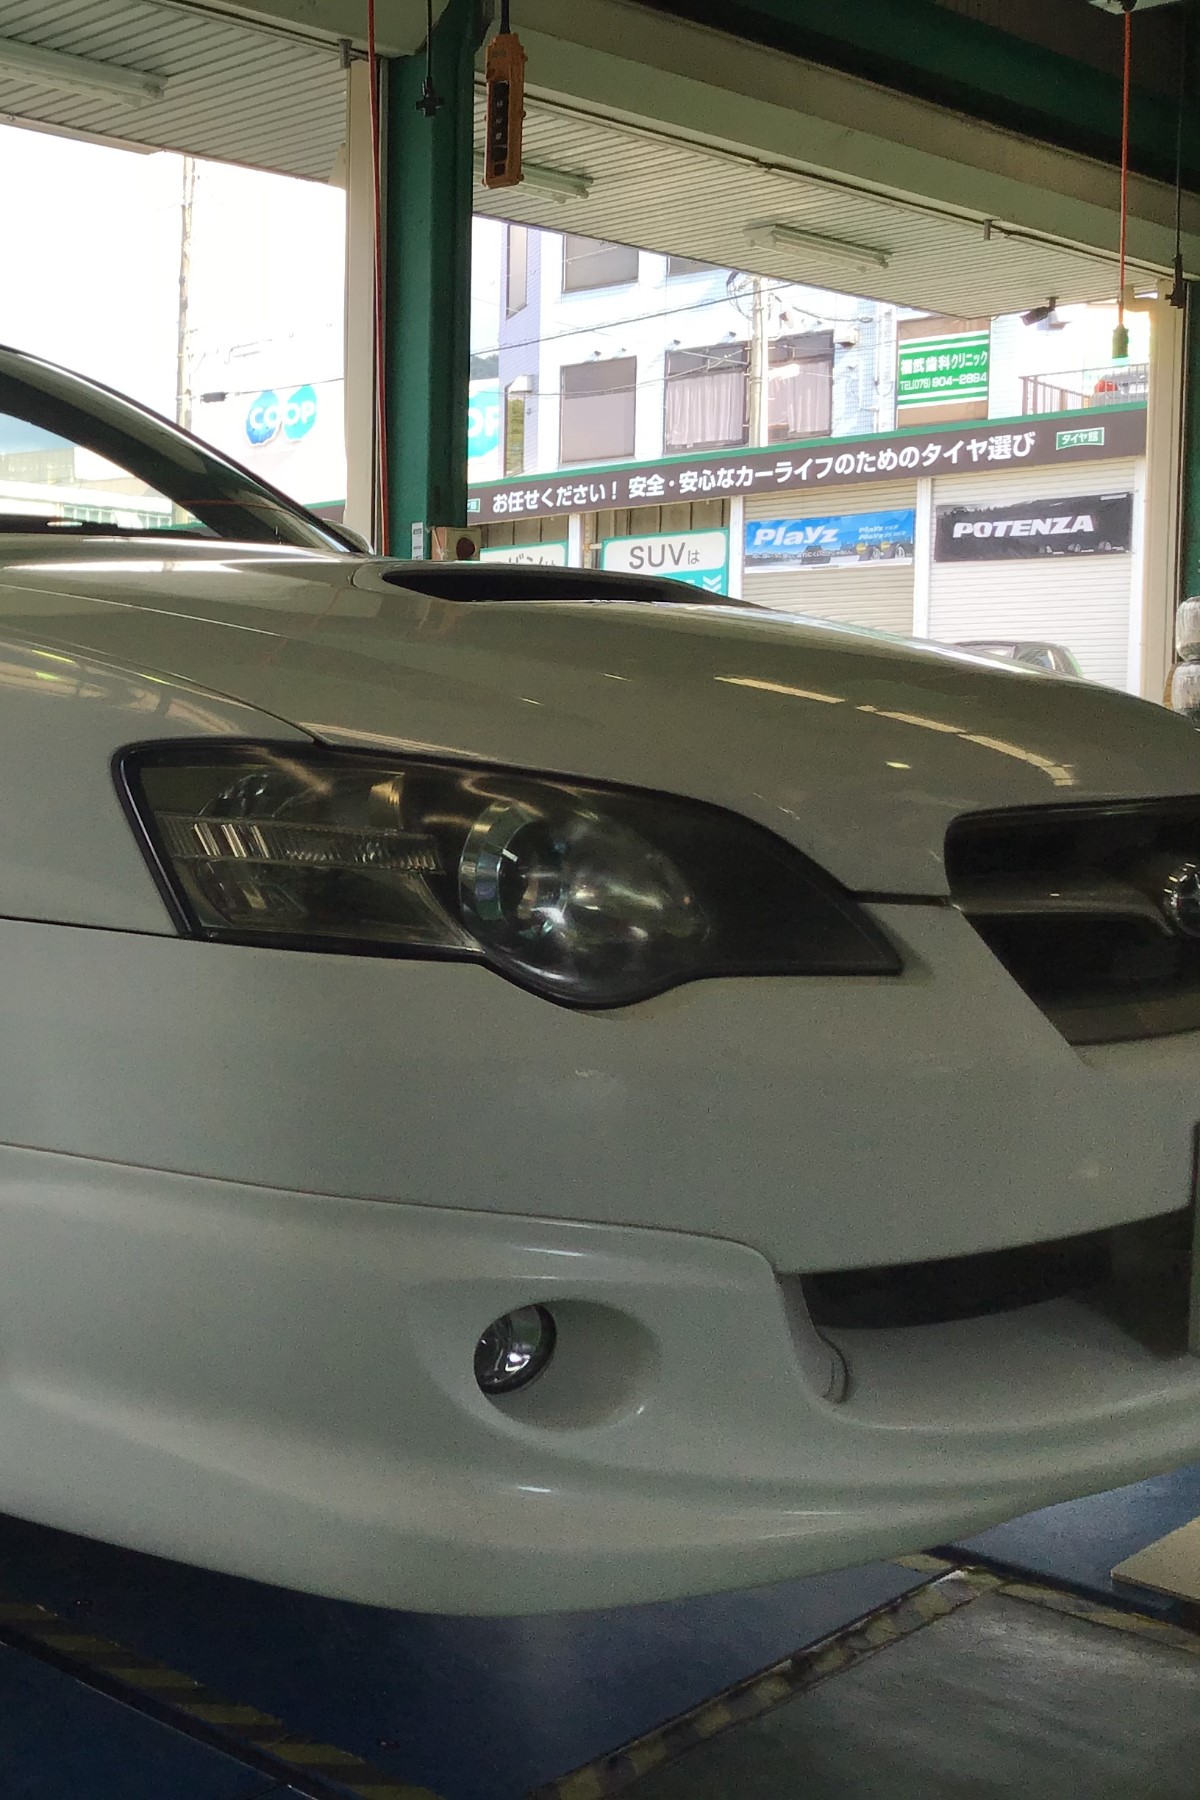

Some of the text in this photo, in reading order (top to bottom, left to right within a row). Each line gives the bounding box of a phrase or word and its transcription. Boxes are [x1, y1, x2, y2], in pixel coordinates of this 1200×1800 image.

[249, 400, 315, 430] COOP
[1062, 430, 1099, 445] タイヤ館
[952, 515, 1094, 539] POTENZA
